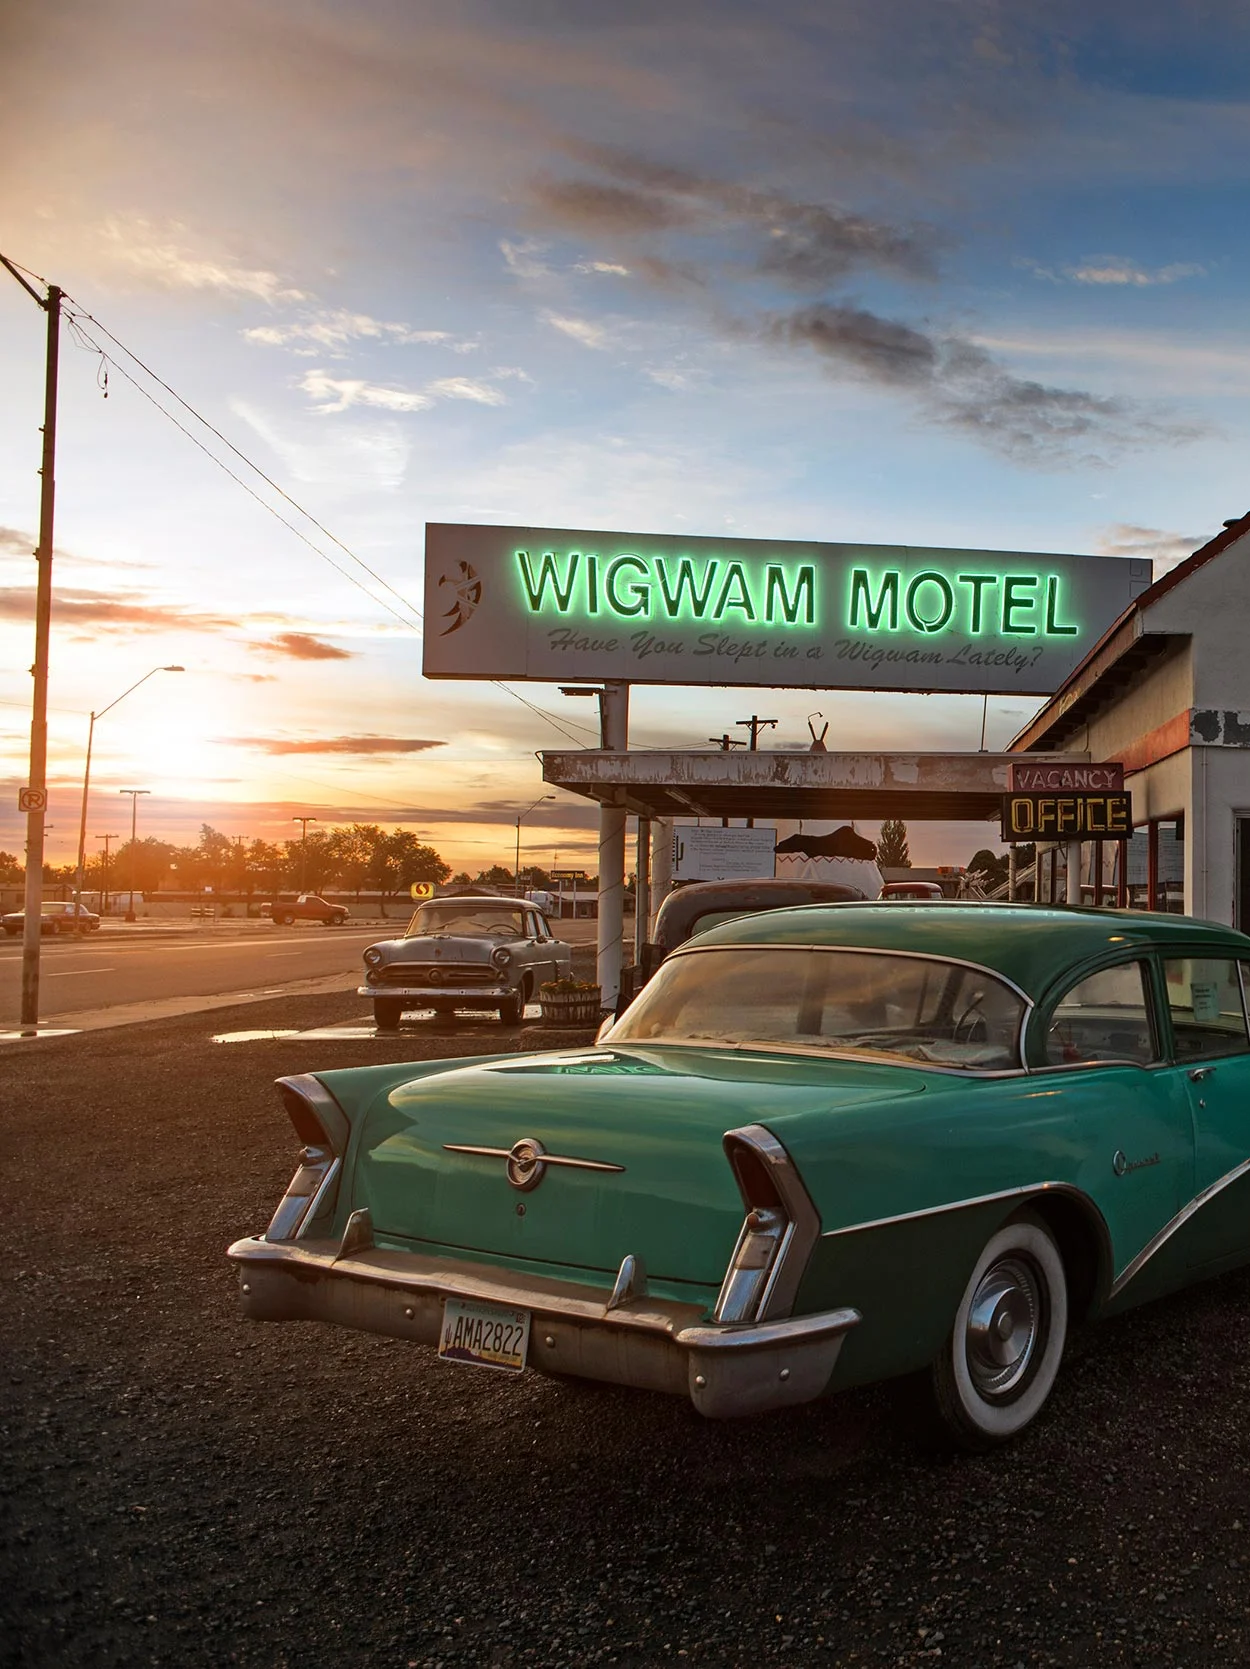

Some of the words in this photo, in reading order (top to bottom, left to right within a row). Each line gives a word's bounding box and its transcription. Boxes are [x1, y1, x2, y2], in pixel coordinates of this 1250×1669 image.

[514, 550, 817, 625] WIGWAM
[847, 567, 1079, 636] MOTEL
[547, 627, 619, 652] Have
[630, 630, 684, 660] You
[693, 632, 767, 664] Slept
[773, 641, 800, 659] in
[806, 646, 824, 660] a
[834, 639, 943, 670] Wigwam
[946, 643, 1044, 674] Lately?
[1016, 769, 1117, 789] VACANCY
[1011, 798, 1127, 834] OFFICE
[453, 1315, 524, 1357] AMA2822
